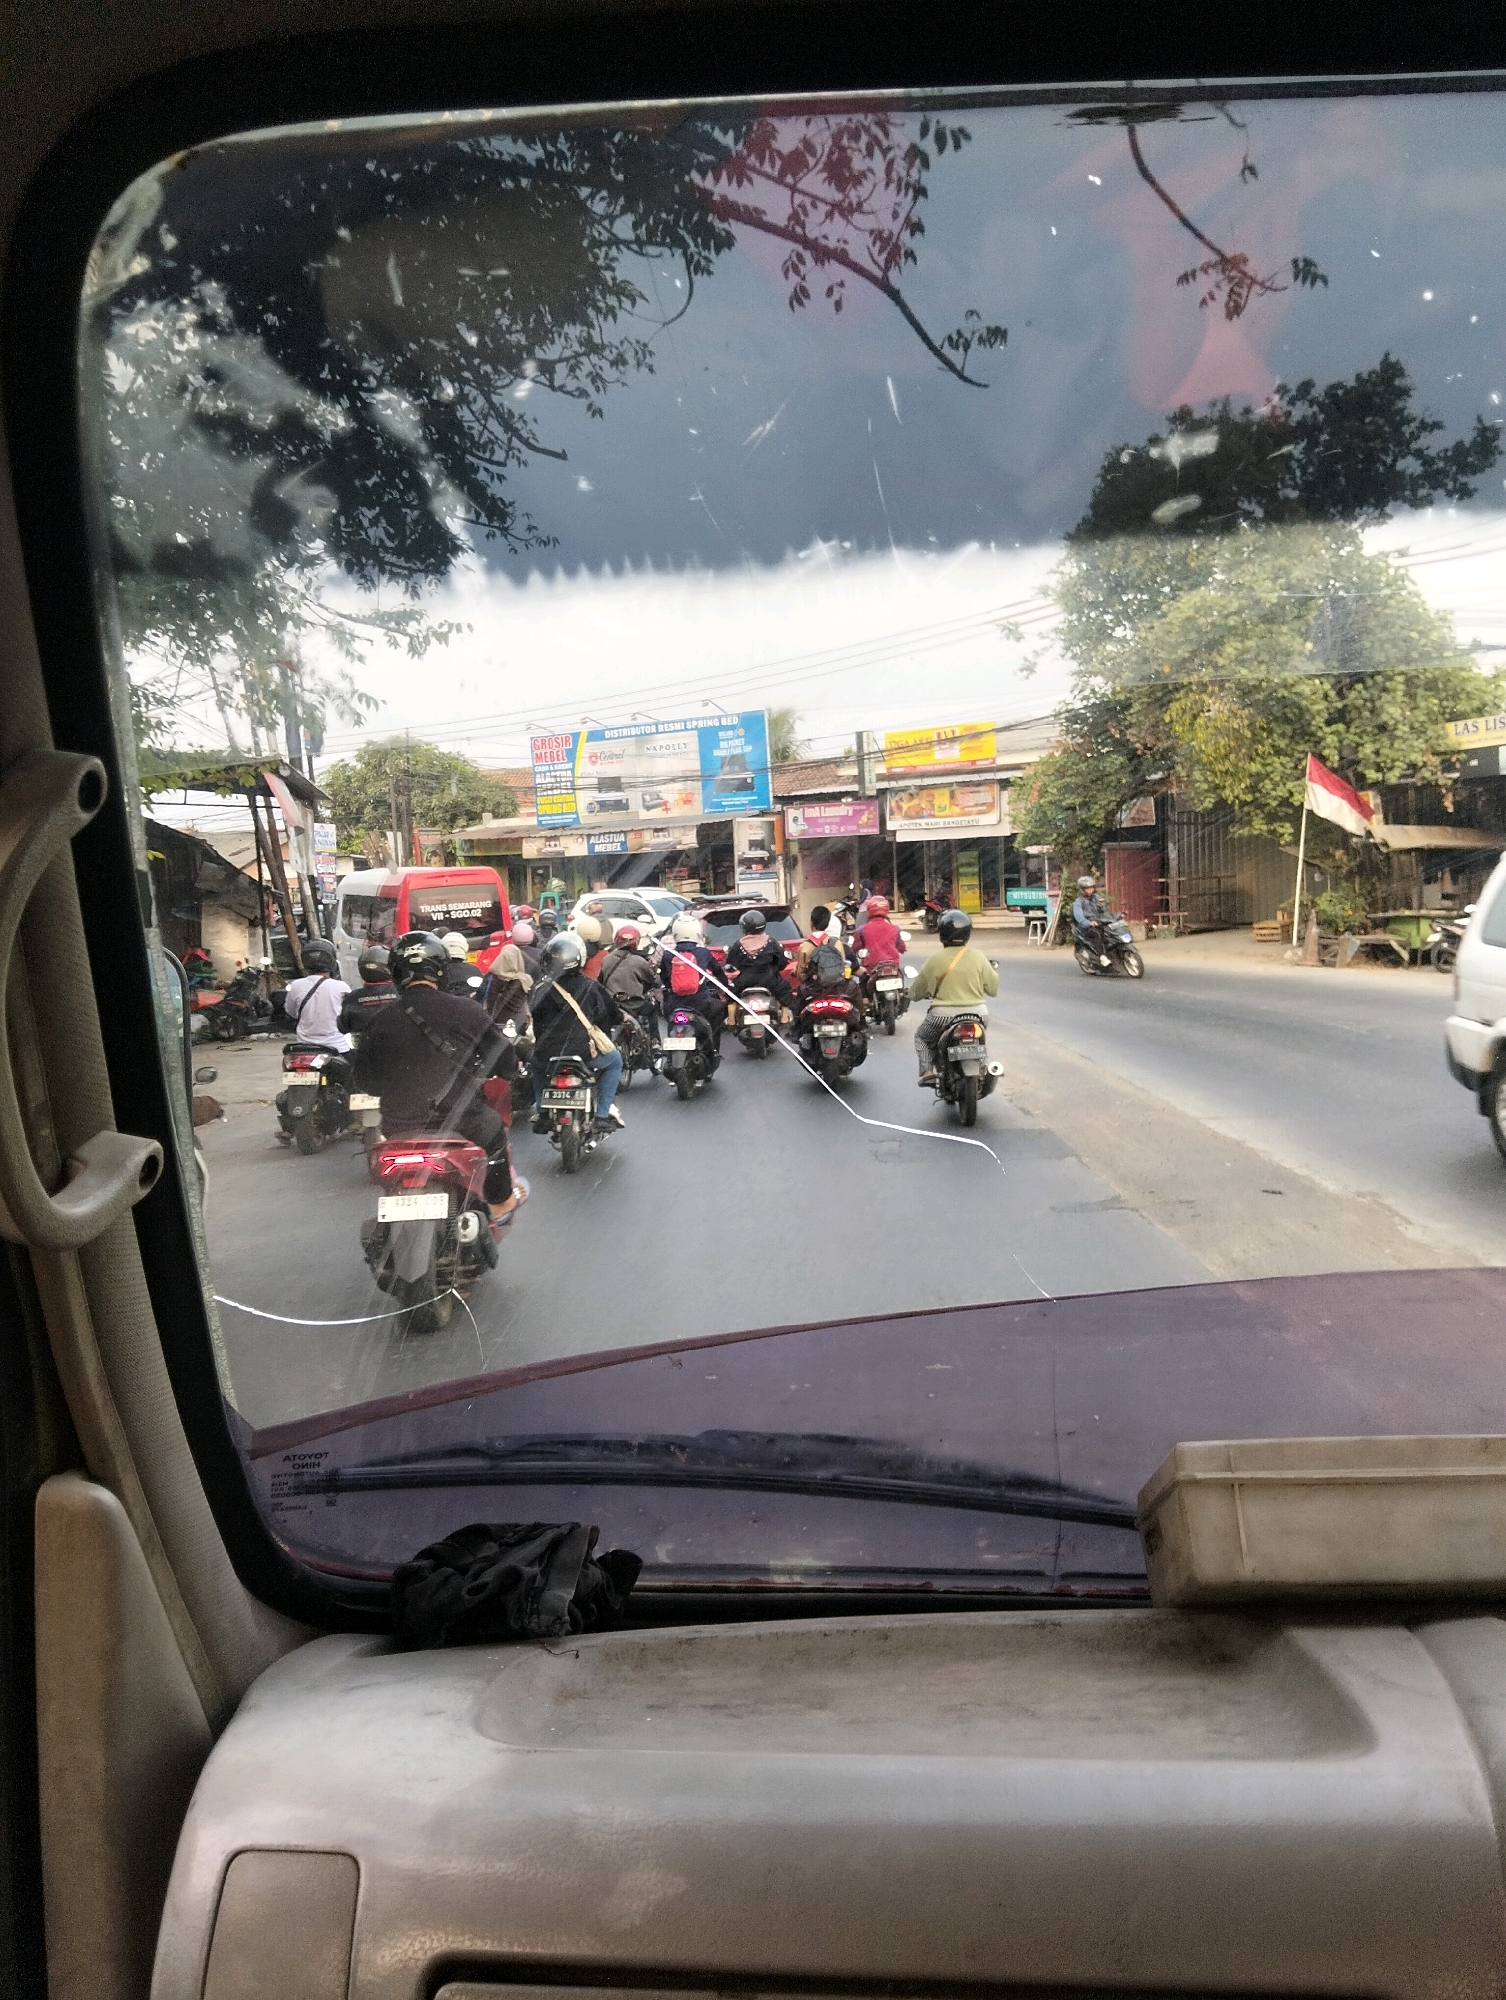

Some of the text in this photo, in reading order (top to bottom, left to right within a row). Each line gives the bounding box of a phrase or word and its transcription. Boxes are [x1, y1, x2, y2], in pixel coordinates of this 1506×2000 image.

[605, 716, 738, 739] DISTRIBUTOR RESMI SPRING BED
[1454, 720, 1479, 736] LAS
[533, 734, 572, 750] GROSIR
[645, 742, 688, 753] NAPOLLY
[535, 750, 567, 764] MEBEL
[589, 833, 625, 844] ALASTUA
[594, 843, 622, 852] MEBEL
[420, 901, 492, 912] TRANS SEMARANG
[431, 912, 444, 920] VII
[450, 909, 482, 919] SGO.02
